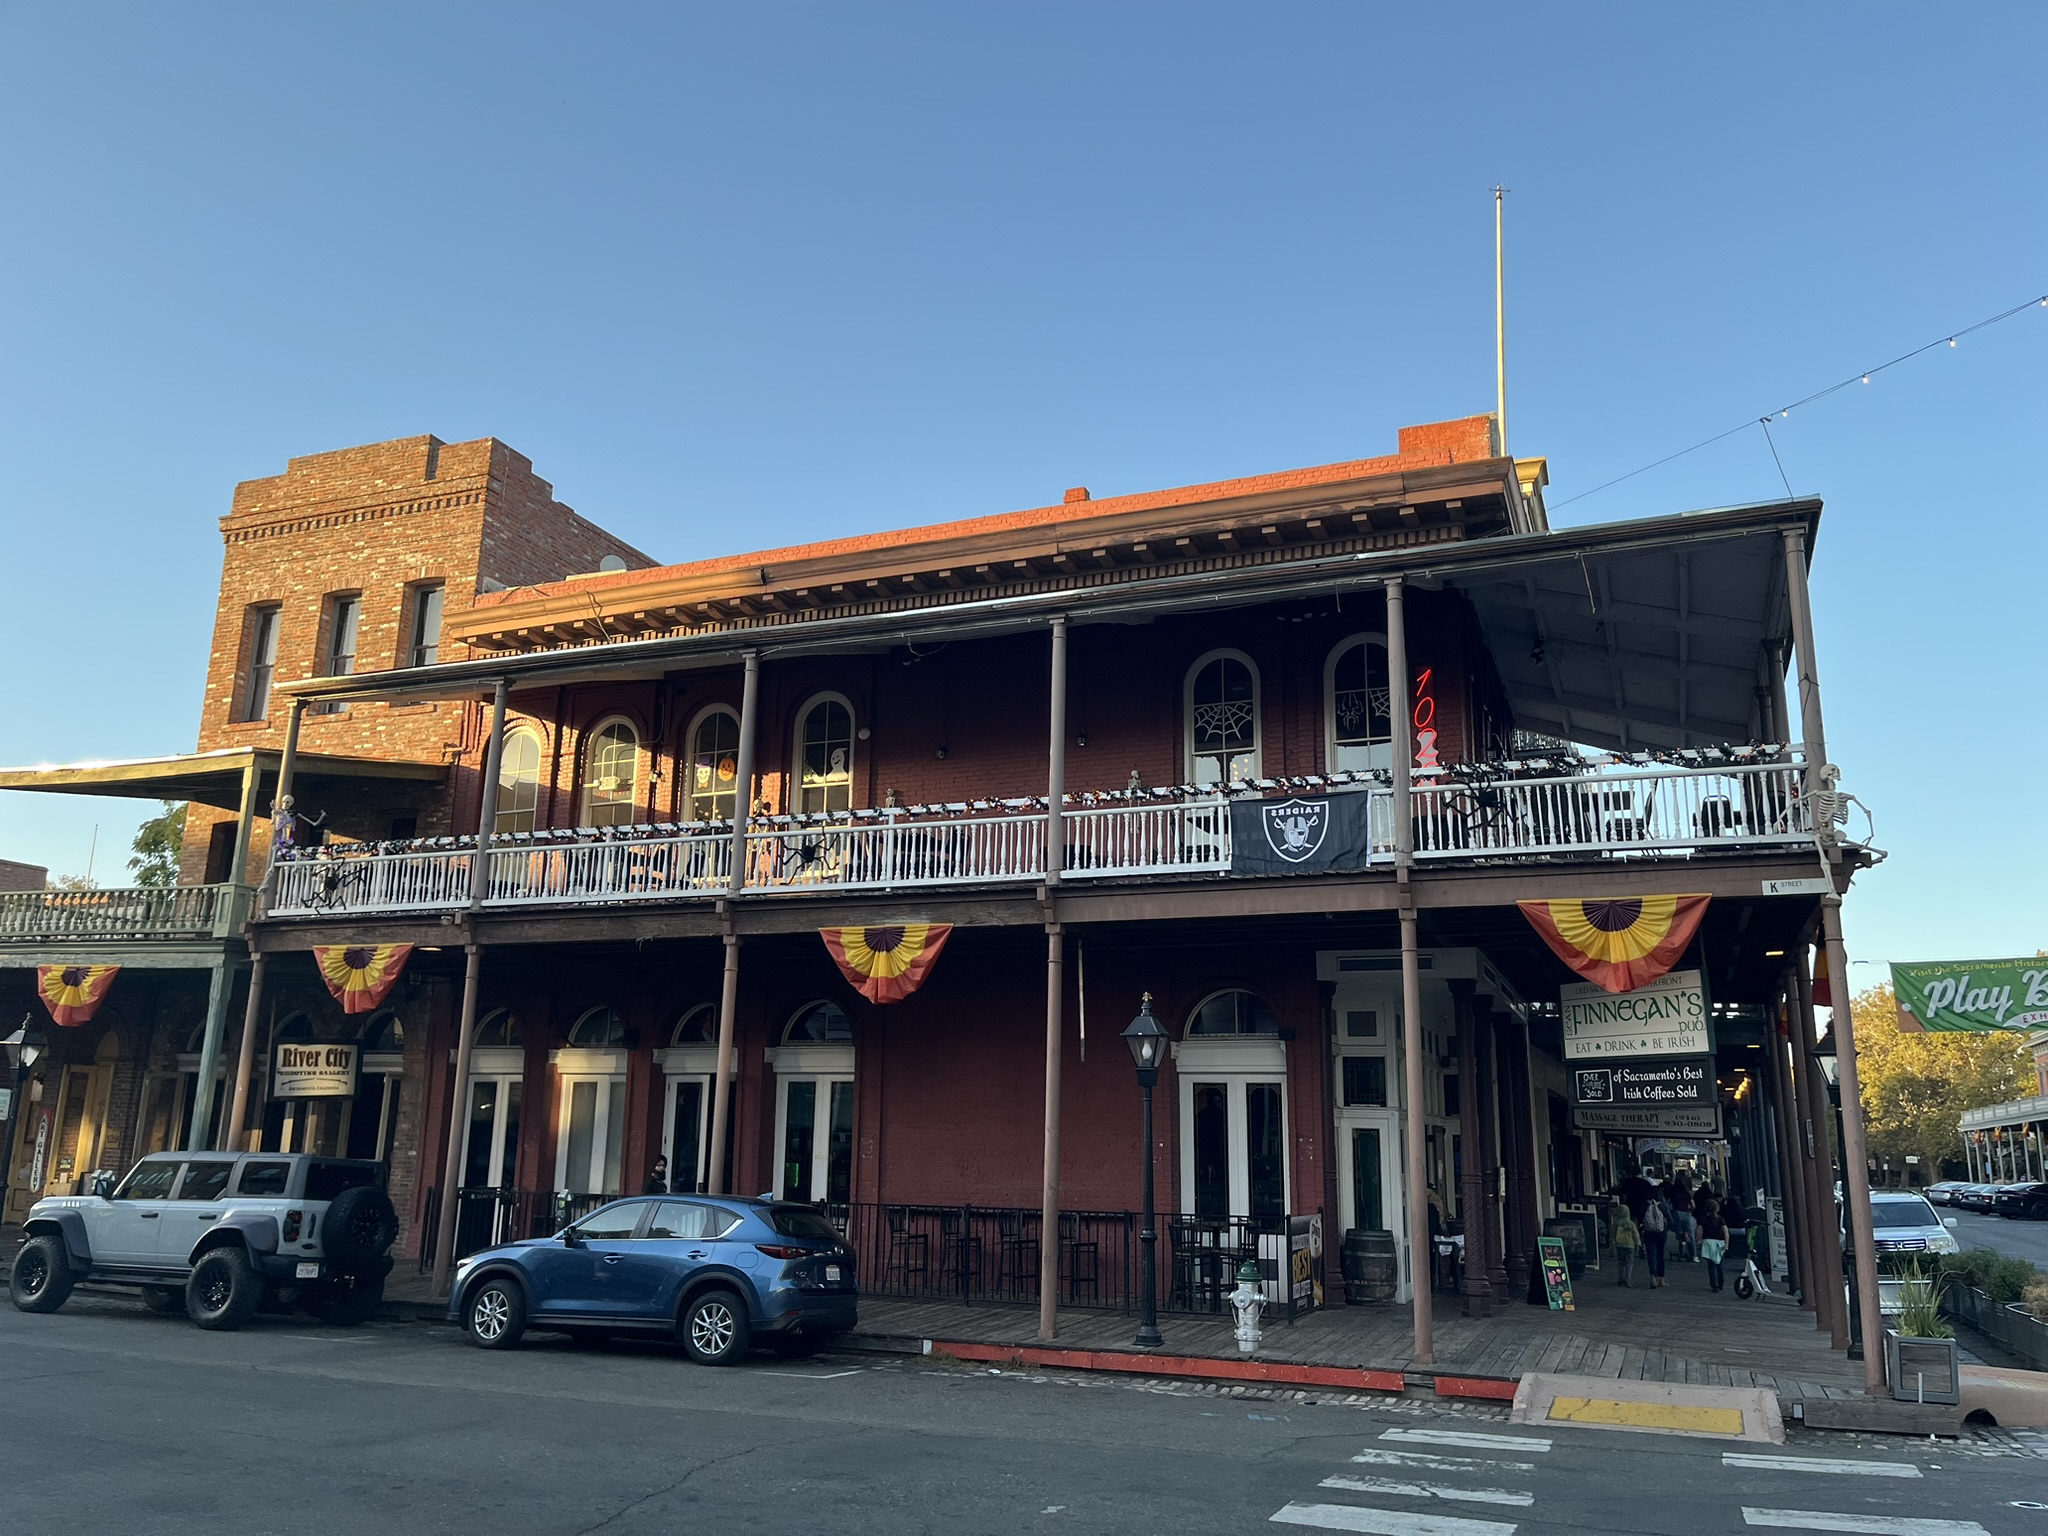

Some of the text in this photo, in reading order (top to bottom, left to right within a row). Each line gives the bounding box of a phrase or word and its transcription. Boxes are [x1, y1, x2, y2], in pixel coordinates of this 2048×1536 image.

[1770, 882, 1778, 893] K
[1910, 968, 1932, 977] Visit
[1935, 966, 1950, 975] the
[1953, 961, 2011, 972] Sacramento
[1575, 985, 1589, 994] OLD
[1923, 975, 2014, 1022] Play
[1571, 992, 1703, 1035] FINNEGAN'S
[1575, 1036, 1695, 1053] EAT DRINK BE IRISH
[282, 1048, 352, 1069] River City
[1583, 1073, 1599, 1081] OVER
[1613, 1066, 1703, 1083] of Sacramento's Best
[1586, 1089, 1602, 1098] SOLD
[1623, 1085, 1697, 1100] Irish Coffees Sold
[1581, 1111, 1659, 1123] MASSAGE THERAPY
[33, 1142, 43, 1190] GALLERY
[1292, 1247, 1311, 1284] BEST
